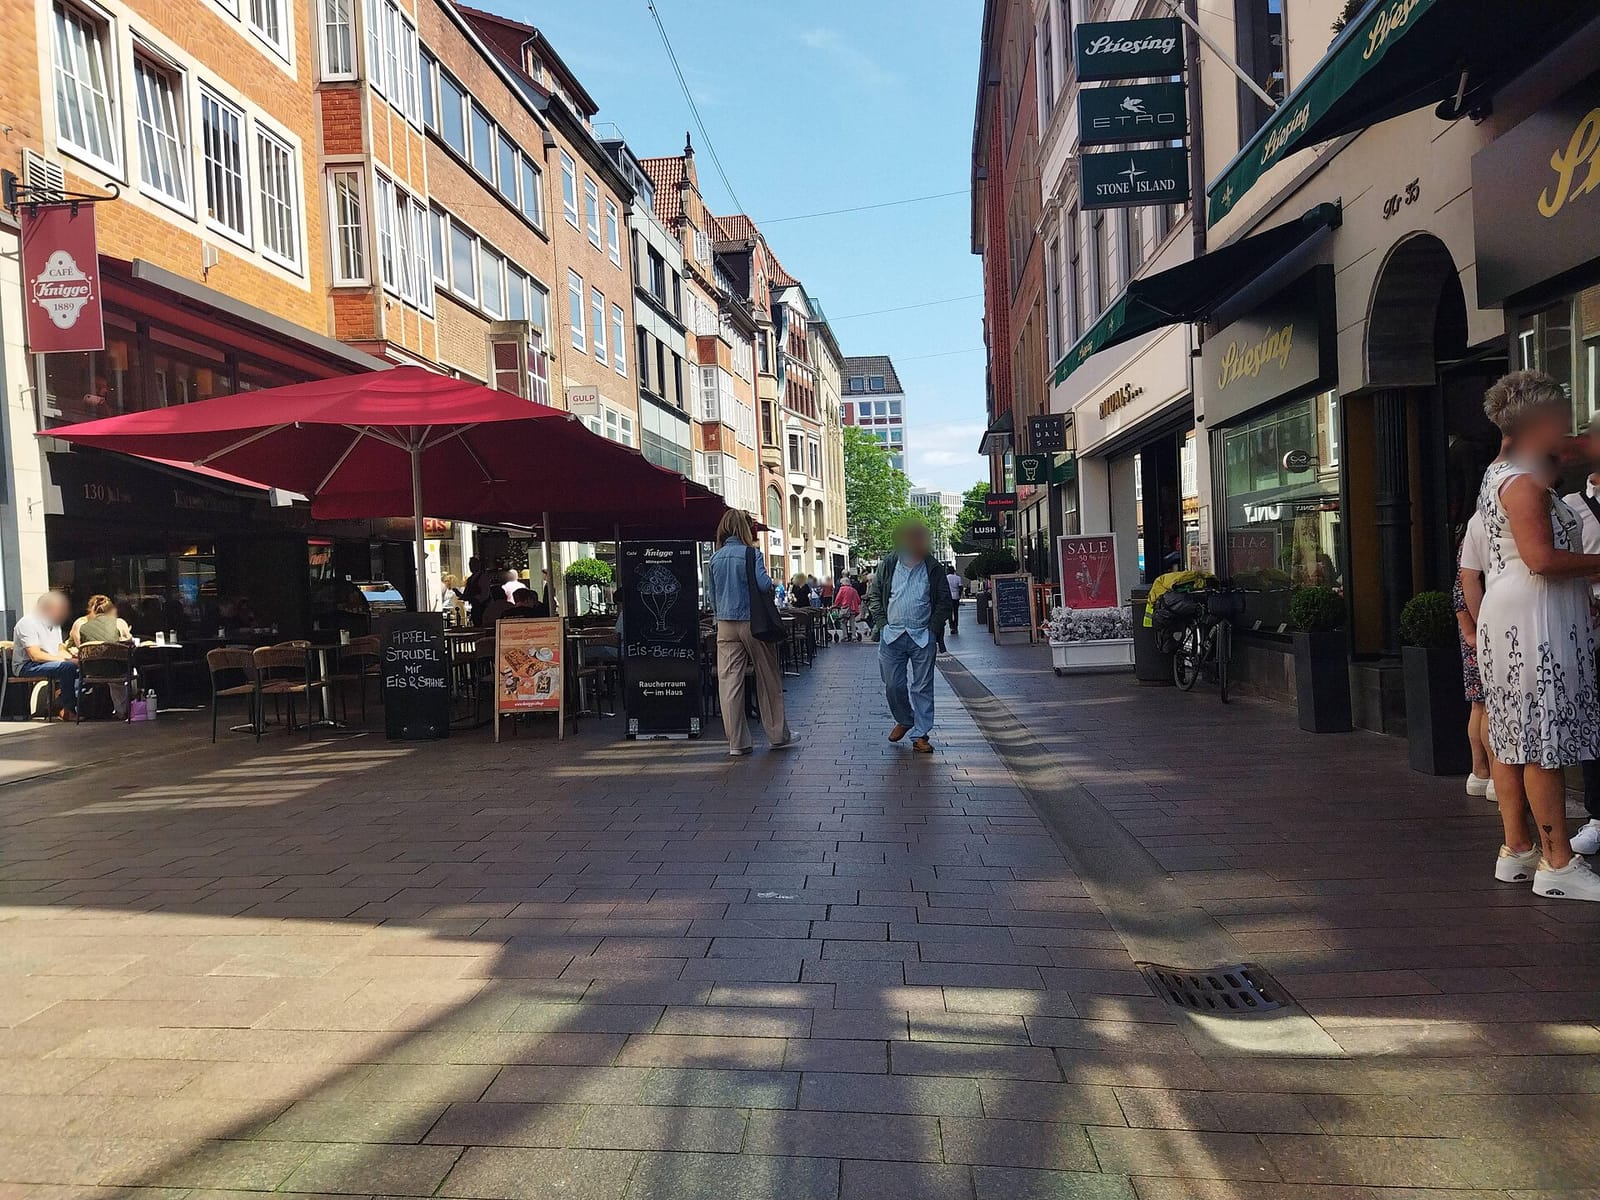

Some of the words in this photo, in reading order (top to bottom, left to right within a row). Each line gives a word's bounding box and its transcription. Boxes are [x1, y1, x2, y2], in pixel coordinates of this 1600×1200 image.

[1085, 35, 1176, 55] Stiesing
[1093, 113, 1175, 128] ETRO
[1260, 101, 1310, 165] Stiesing
[1096, 182, 1130, 196] STONE
[1136, 179, 1176, 193] ISLAND
[1404, 177, 1420, 205] 35
[49, 266, 74, 277] CAFÉ
[36, 282, 89, 298] Knigge
[53, 302, 75, 312] 1889
[1218, 323, 1294, 390] Stiesing
[572, 394, 595, 402] GULP
[974, 526, 996, 534] LUSH
[644, 548, 674, 557] Knigge
[1067, 541, 1108, 555] SALE
[386, 646, 440, 662] STRUDEL
